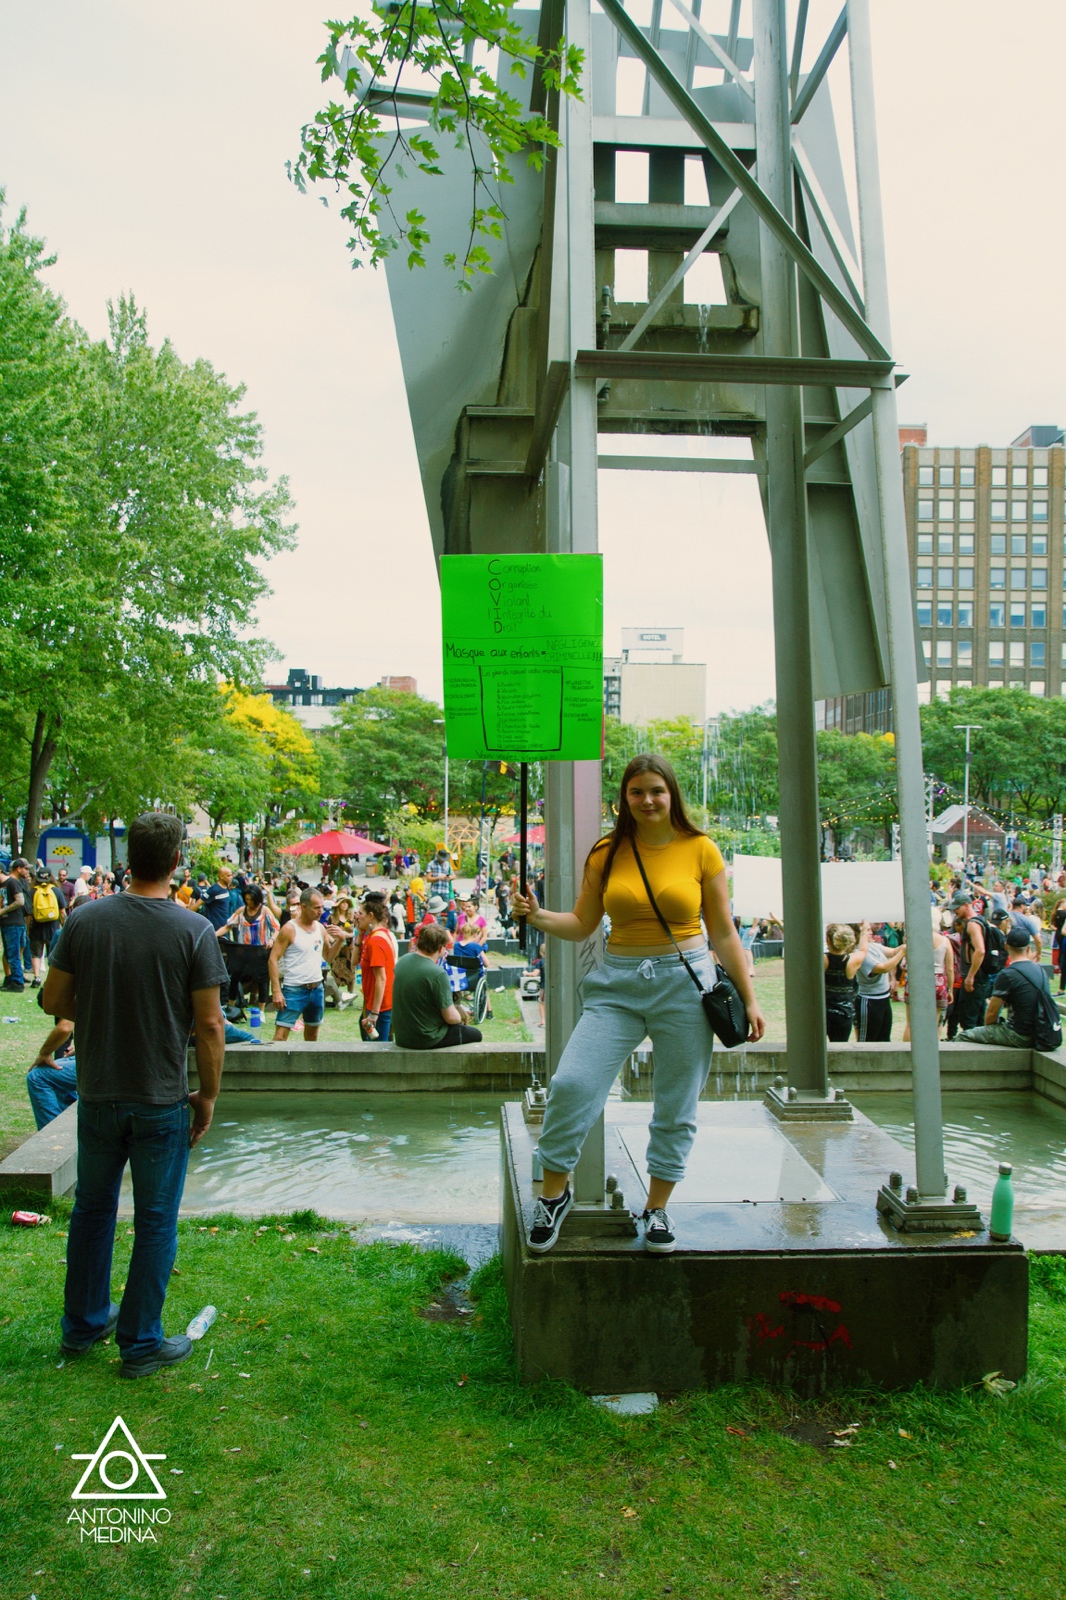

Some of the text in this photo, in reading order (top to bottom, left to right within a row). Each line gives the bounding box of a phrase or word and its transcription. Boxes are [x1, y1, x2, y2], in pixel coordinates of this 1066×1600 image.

[487, 559, 541, 576] Corruption
[489, 591, 531, 607] Violant
[539, 604, 552, 618] du
[493, 620, 518, 634] Droit
[445, 642, 485, 664] Masque
[490, 649, 508, 657] aux
[510, 645, 540, 659] enfants
